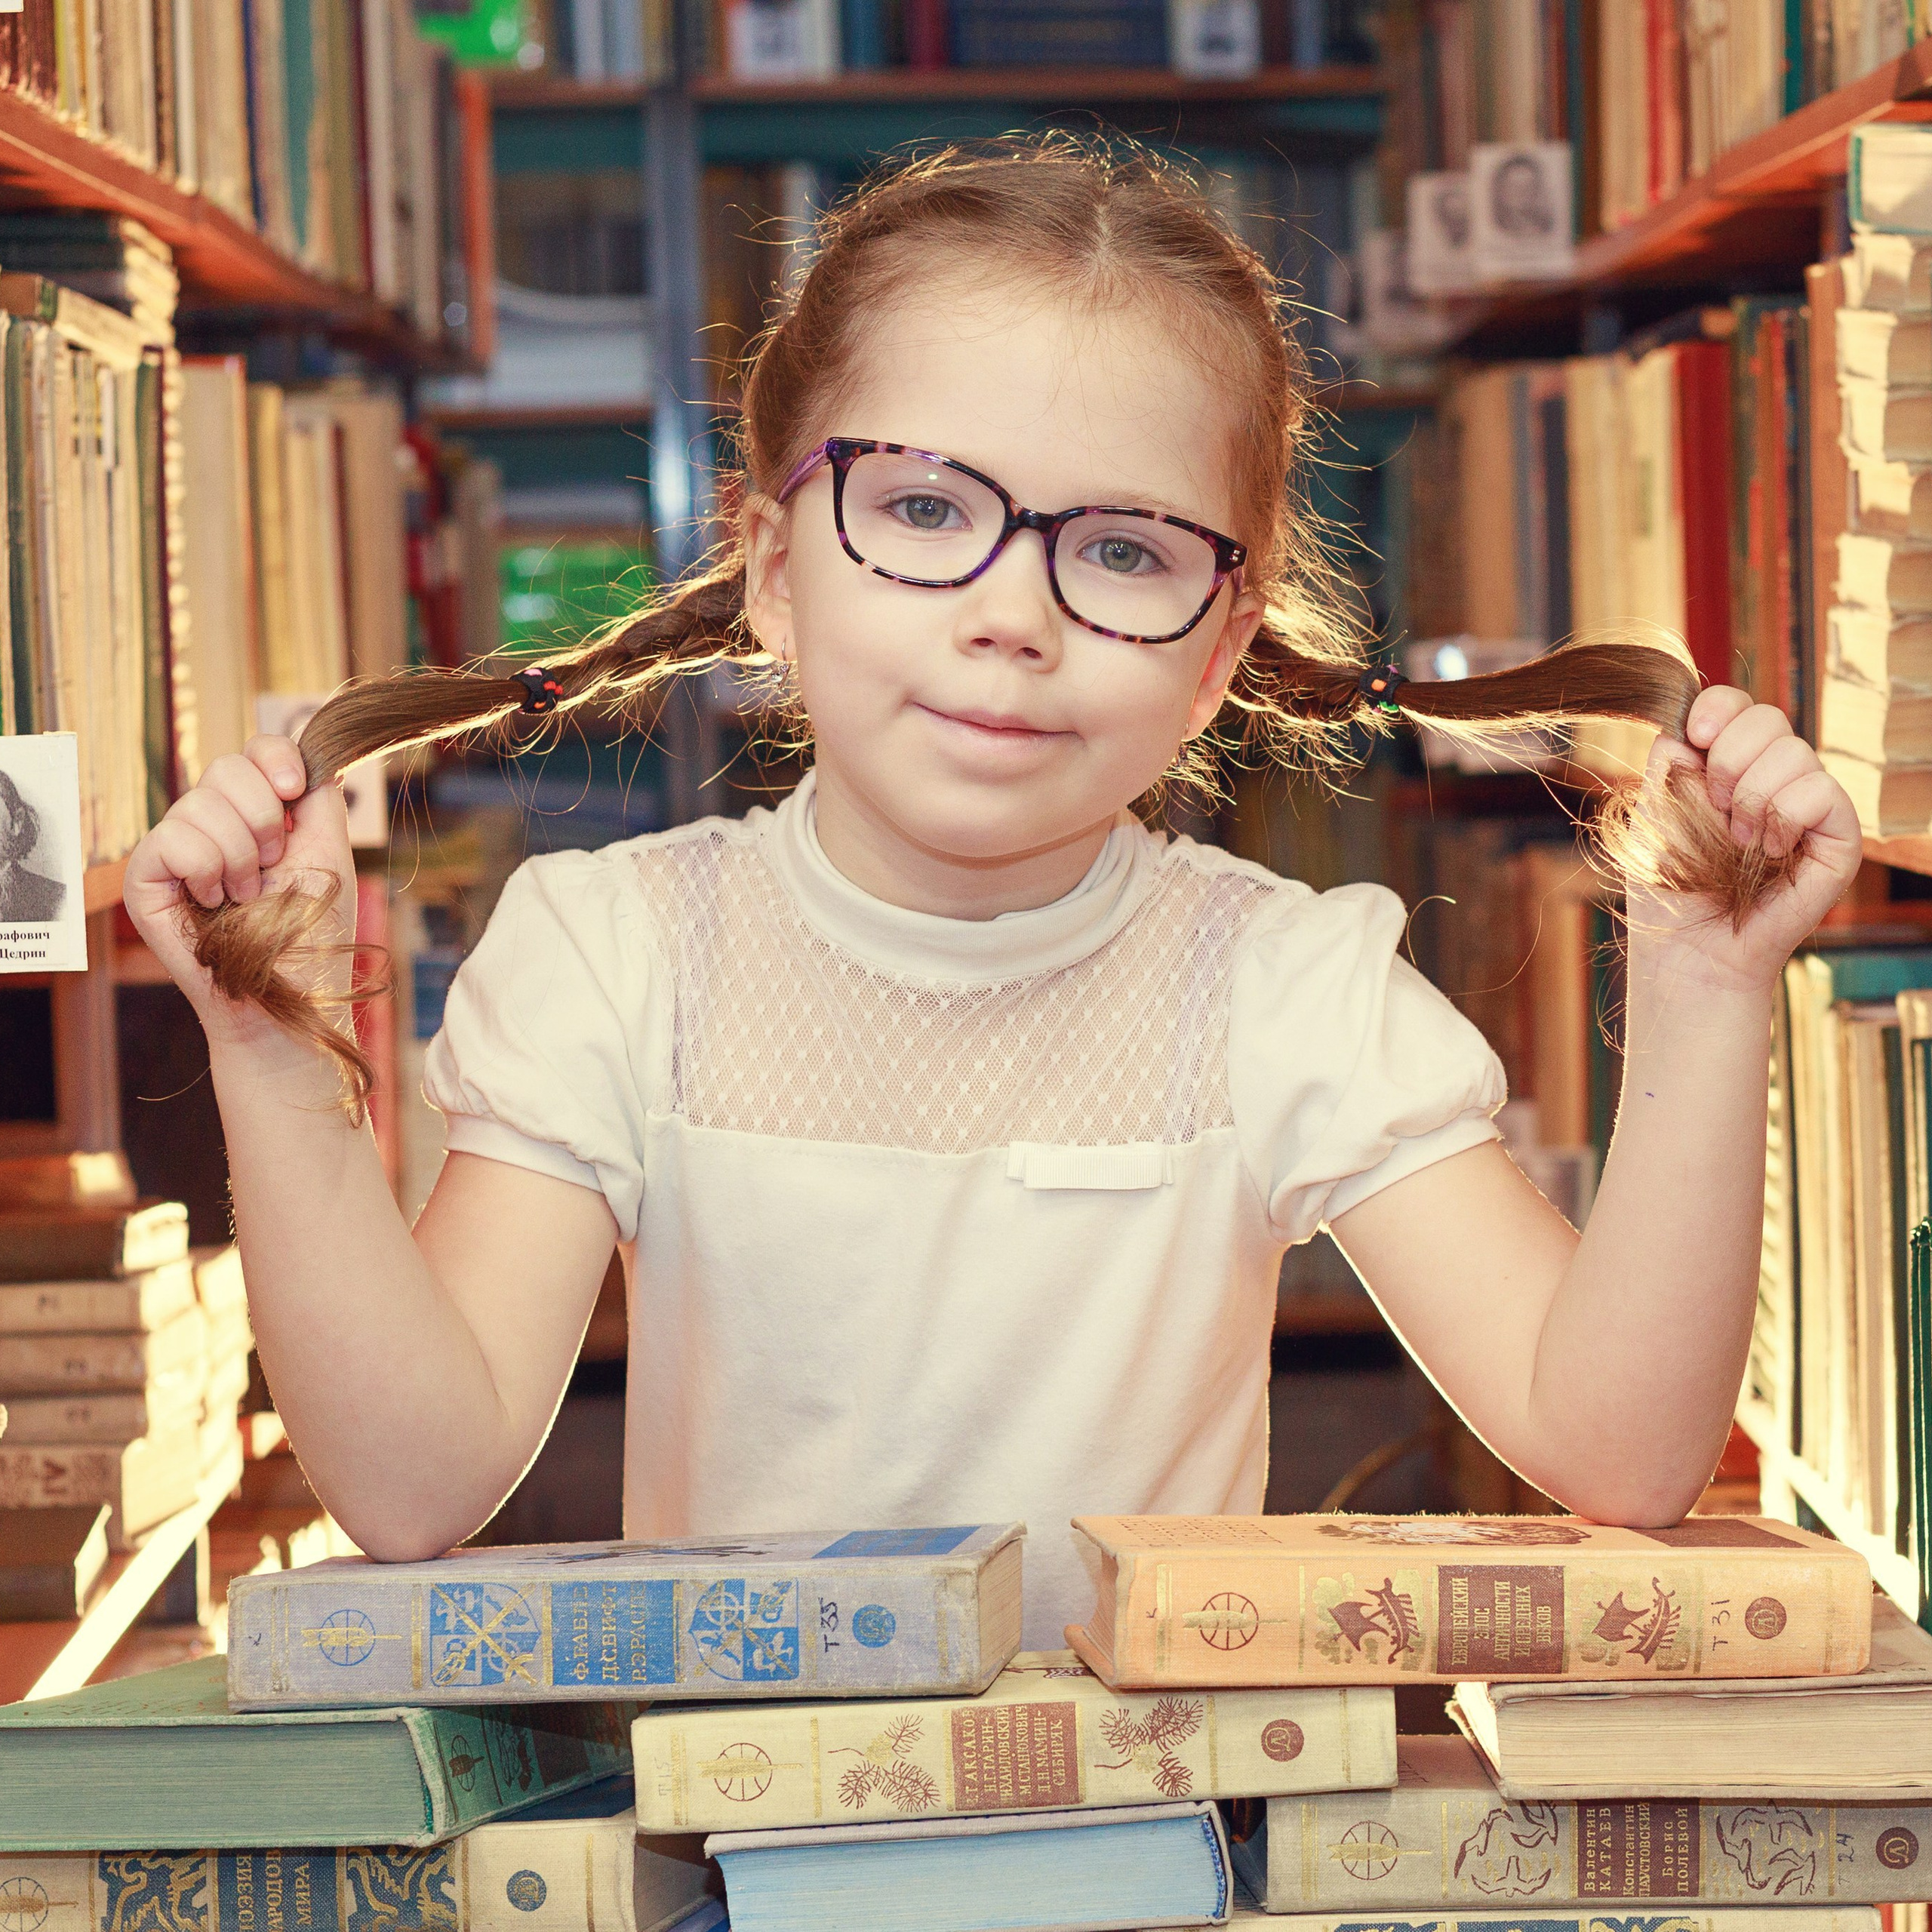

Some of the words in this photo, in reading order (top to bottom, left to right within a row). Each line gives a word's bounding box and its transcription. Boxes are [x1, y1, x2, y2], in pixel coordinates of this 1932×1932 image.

[1450, 1577, 1469, 1665] ЕВРОПЕЙСКИЙ
[1474, 1607, 1490, 1639] ЭПОС
[1494, 1580, 1511, 1661] АНТИЧНОСТИ
[1515, 1585, 1533, 1644] СРЕДНИХ
[1537, 1605, 1552, 1642] ВЕКОВ
[1515, 1647, 1530, 1657] И
[1051, 1719, 1066, 1786] СИБИРЯК
[1584, 1808, 1595, 1891] Валентин
[1599, 1807, 1611, 1891] КАТАЕВ
[1623, 1804, 1635, 1896] Константин
[1637, 1802, 1651, 1897] ПАУСТОВСКИЙ
[1663, 1821, 1674, 1877] Борис
[1675, 1807, 1689, 1892] ПОЛЕВОЙ
[294, 1862, 312, 1925] МИРА
